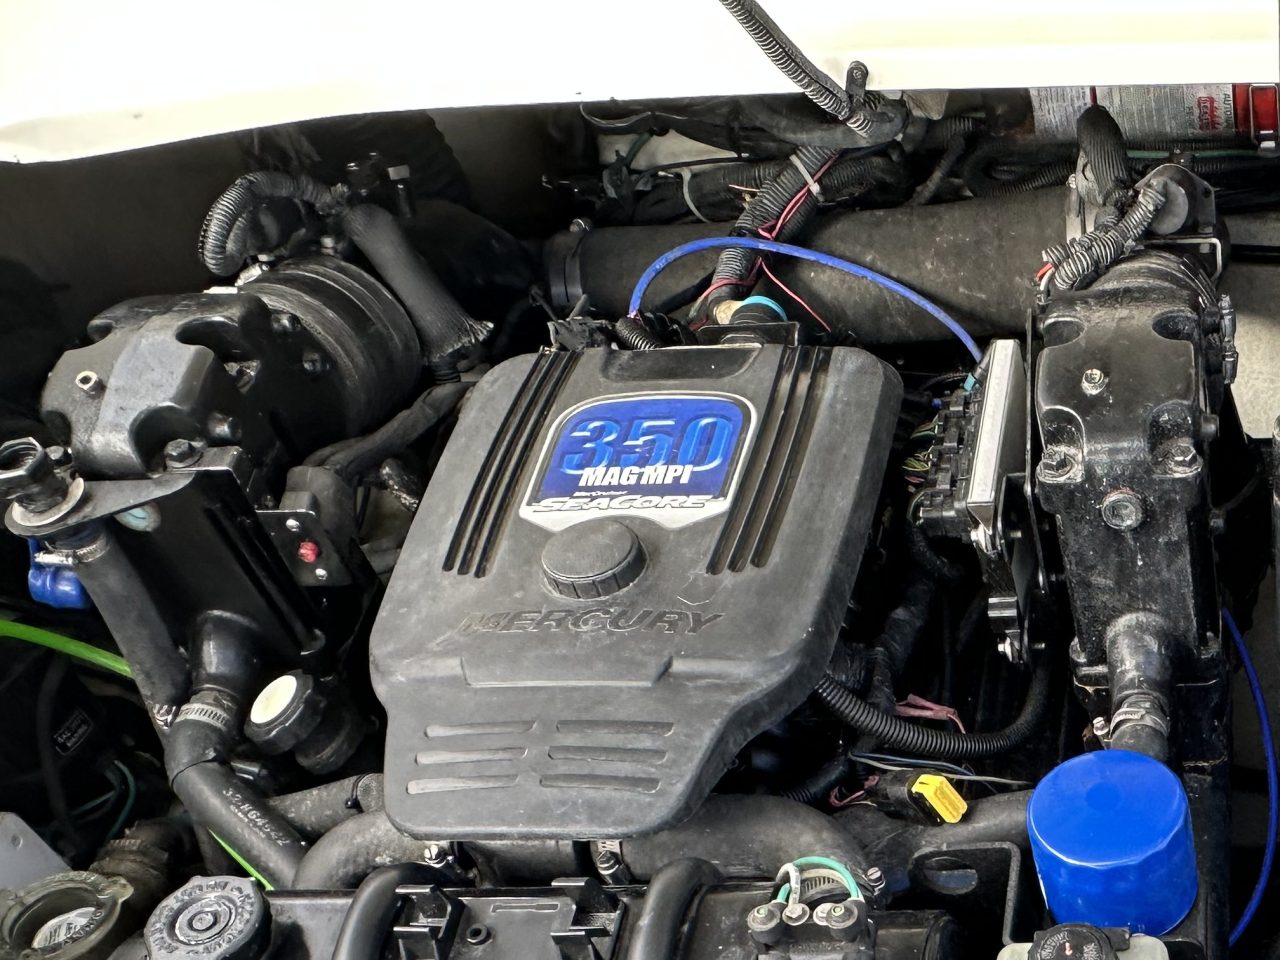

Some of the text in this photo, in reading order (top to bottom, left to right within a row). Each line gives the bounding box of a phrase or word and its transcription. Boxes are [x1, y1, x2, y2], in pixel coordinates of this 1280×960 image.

[560, 416, 733, 475] 350
[577, 464, 695, 487] MAG MPI
[453, 606, 725, 634] MERCURY
